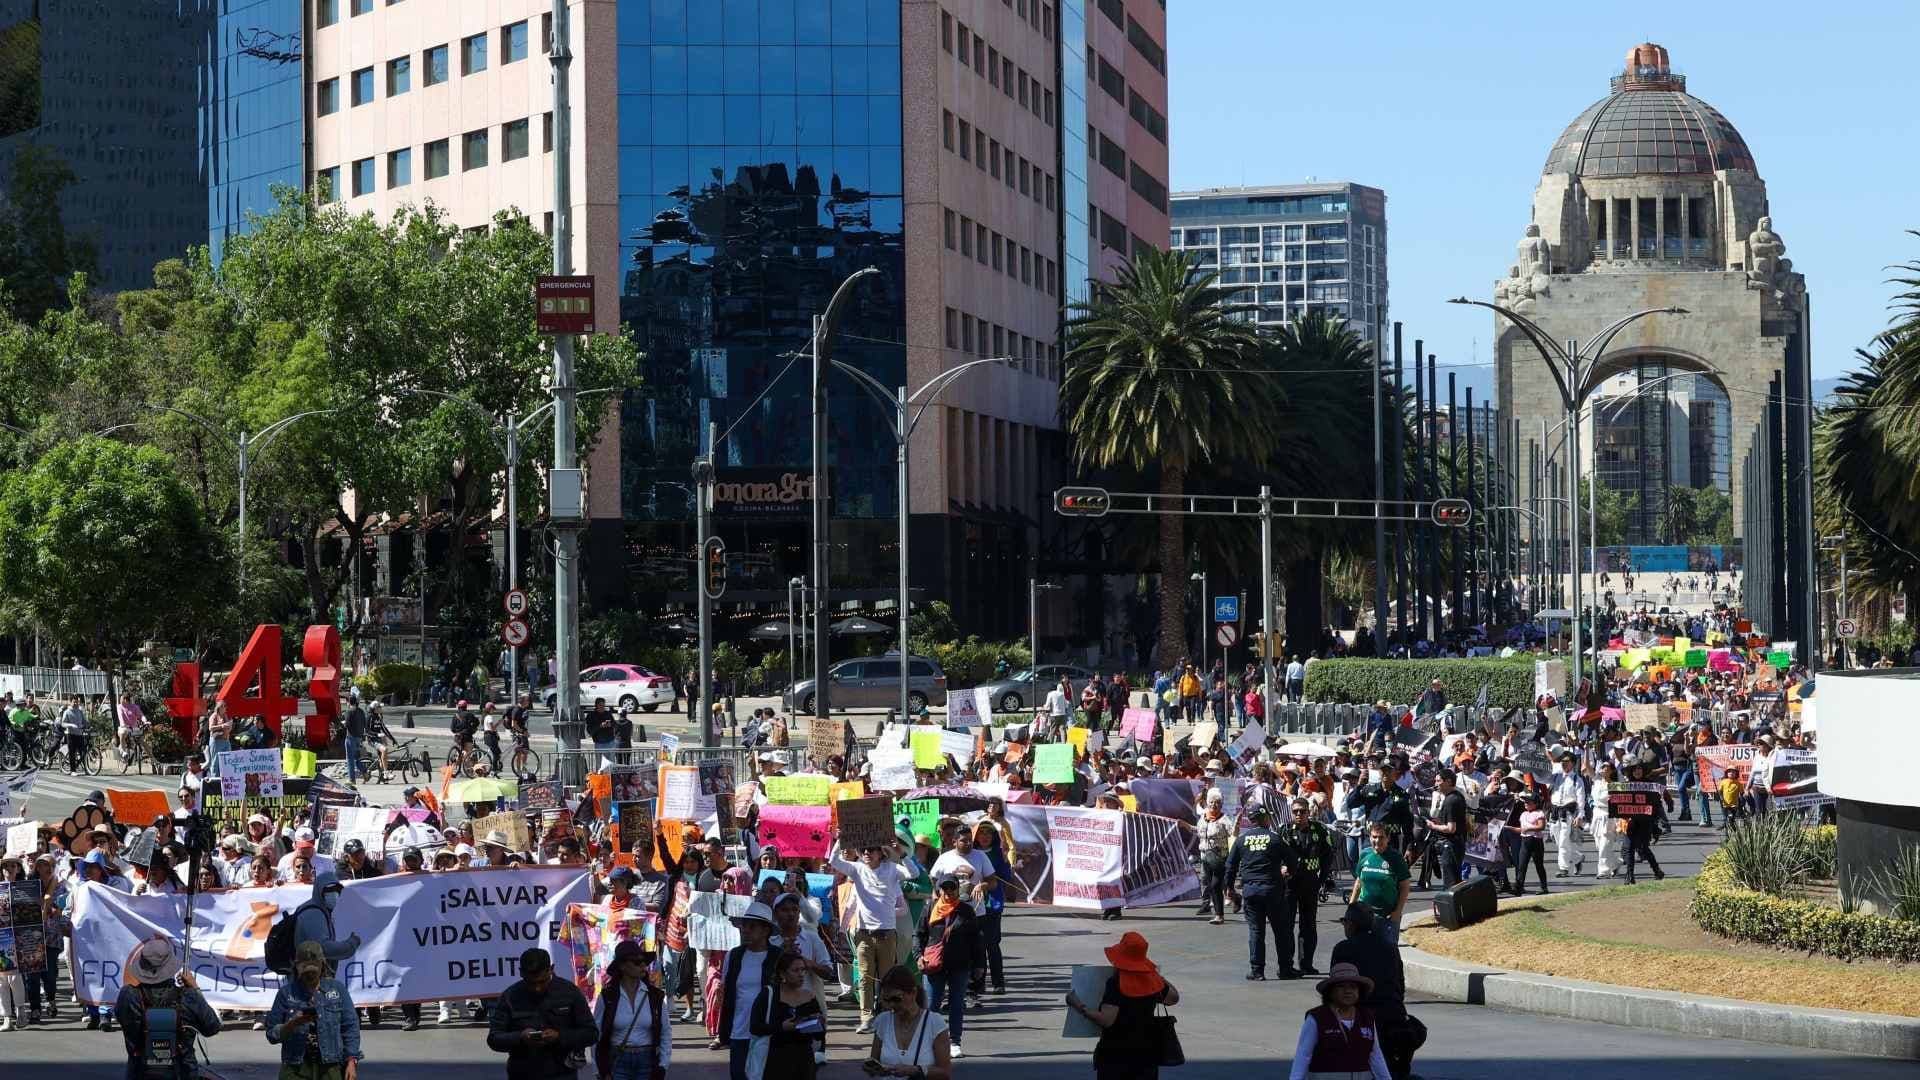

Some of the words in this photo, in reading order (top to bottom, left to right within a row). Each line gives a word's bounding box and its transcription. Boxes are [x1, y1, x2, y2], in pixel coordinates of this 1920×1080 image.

[543, 299, 585, 312] 911
[713, 482, 778, 505] onora
[1730, 748, 1760, 760] JUST
[440, 885, 549, 914] ¡SALVAR
[413, 922, 492, 947] VIDAS
[501, 920, 541, 941] NO
[549, 920, 561, 941] E
[345, 959, 403, 989] A.C.
[448, 957, 521, 981] DELIT
